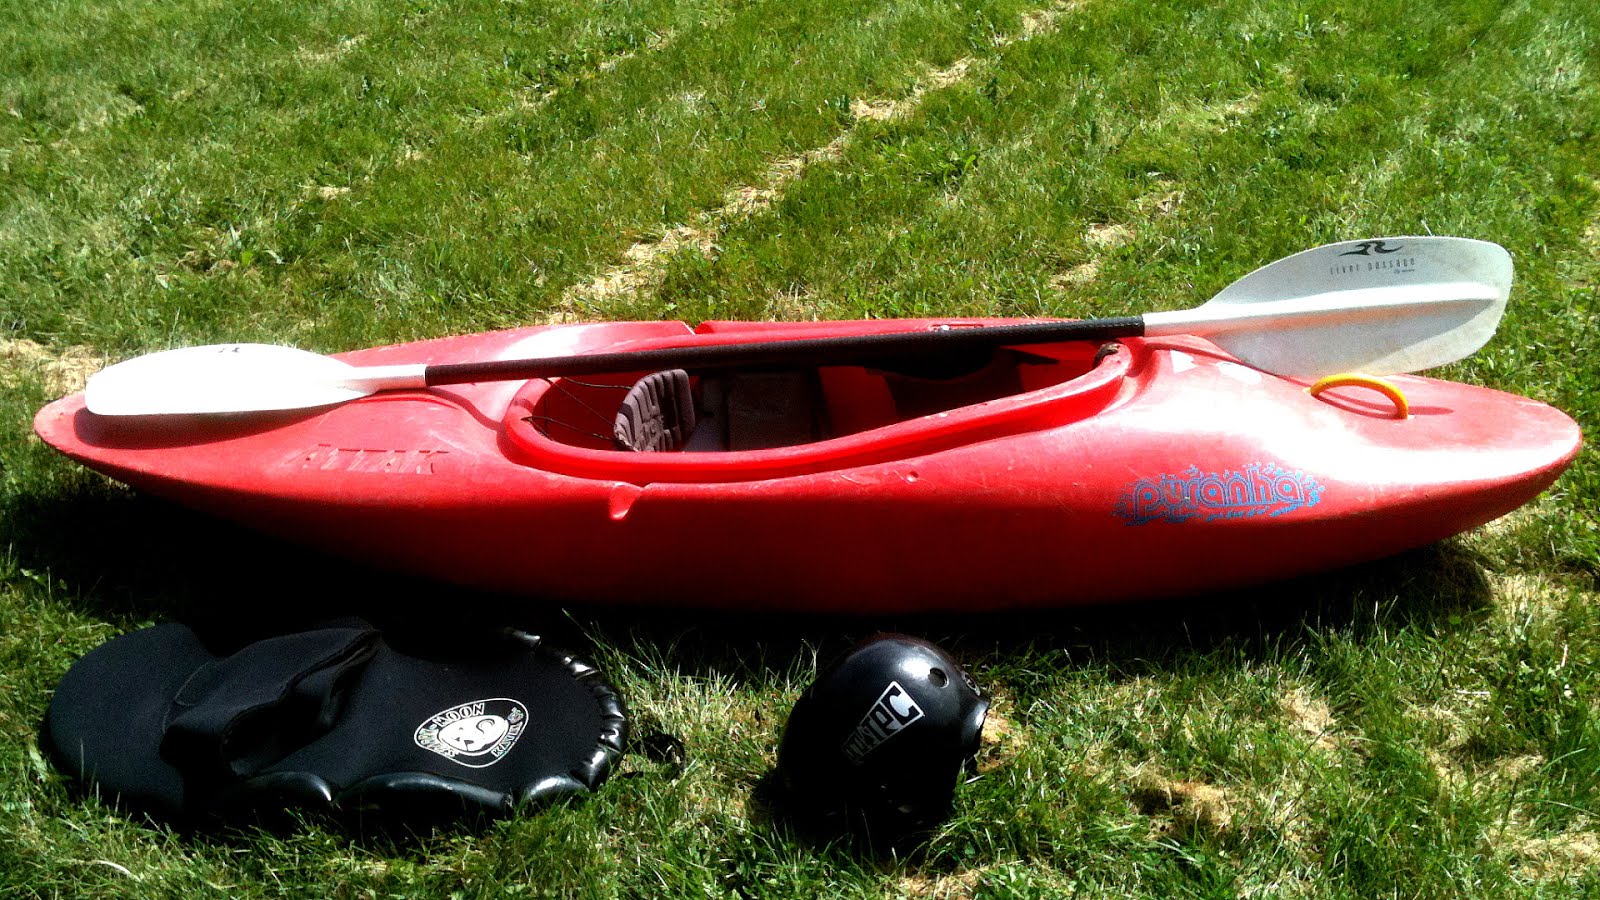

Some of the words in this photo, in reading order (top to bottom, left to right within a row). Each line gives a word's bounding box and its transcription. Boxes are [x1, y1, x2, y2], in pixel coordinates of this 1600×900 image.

[1330, 263, 1360, 275] river
[1367, 257, 1416, 272] passage
[432, 702, 486, 728] MOON
